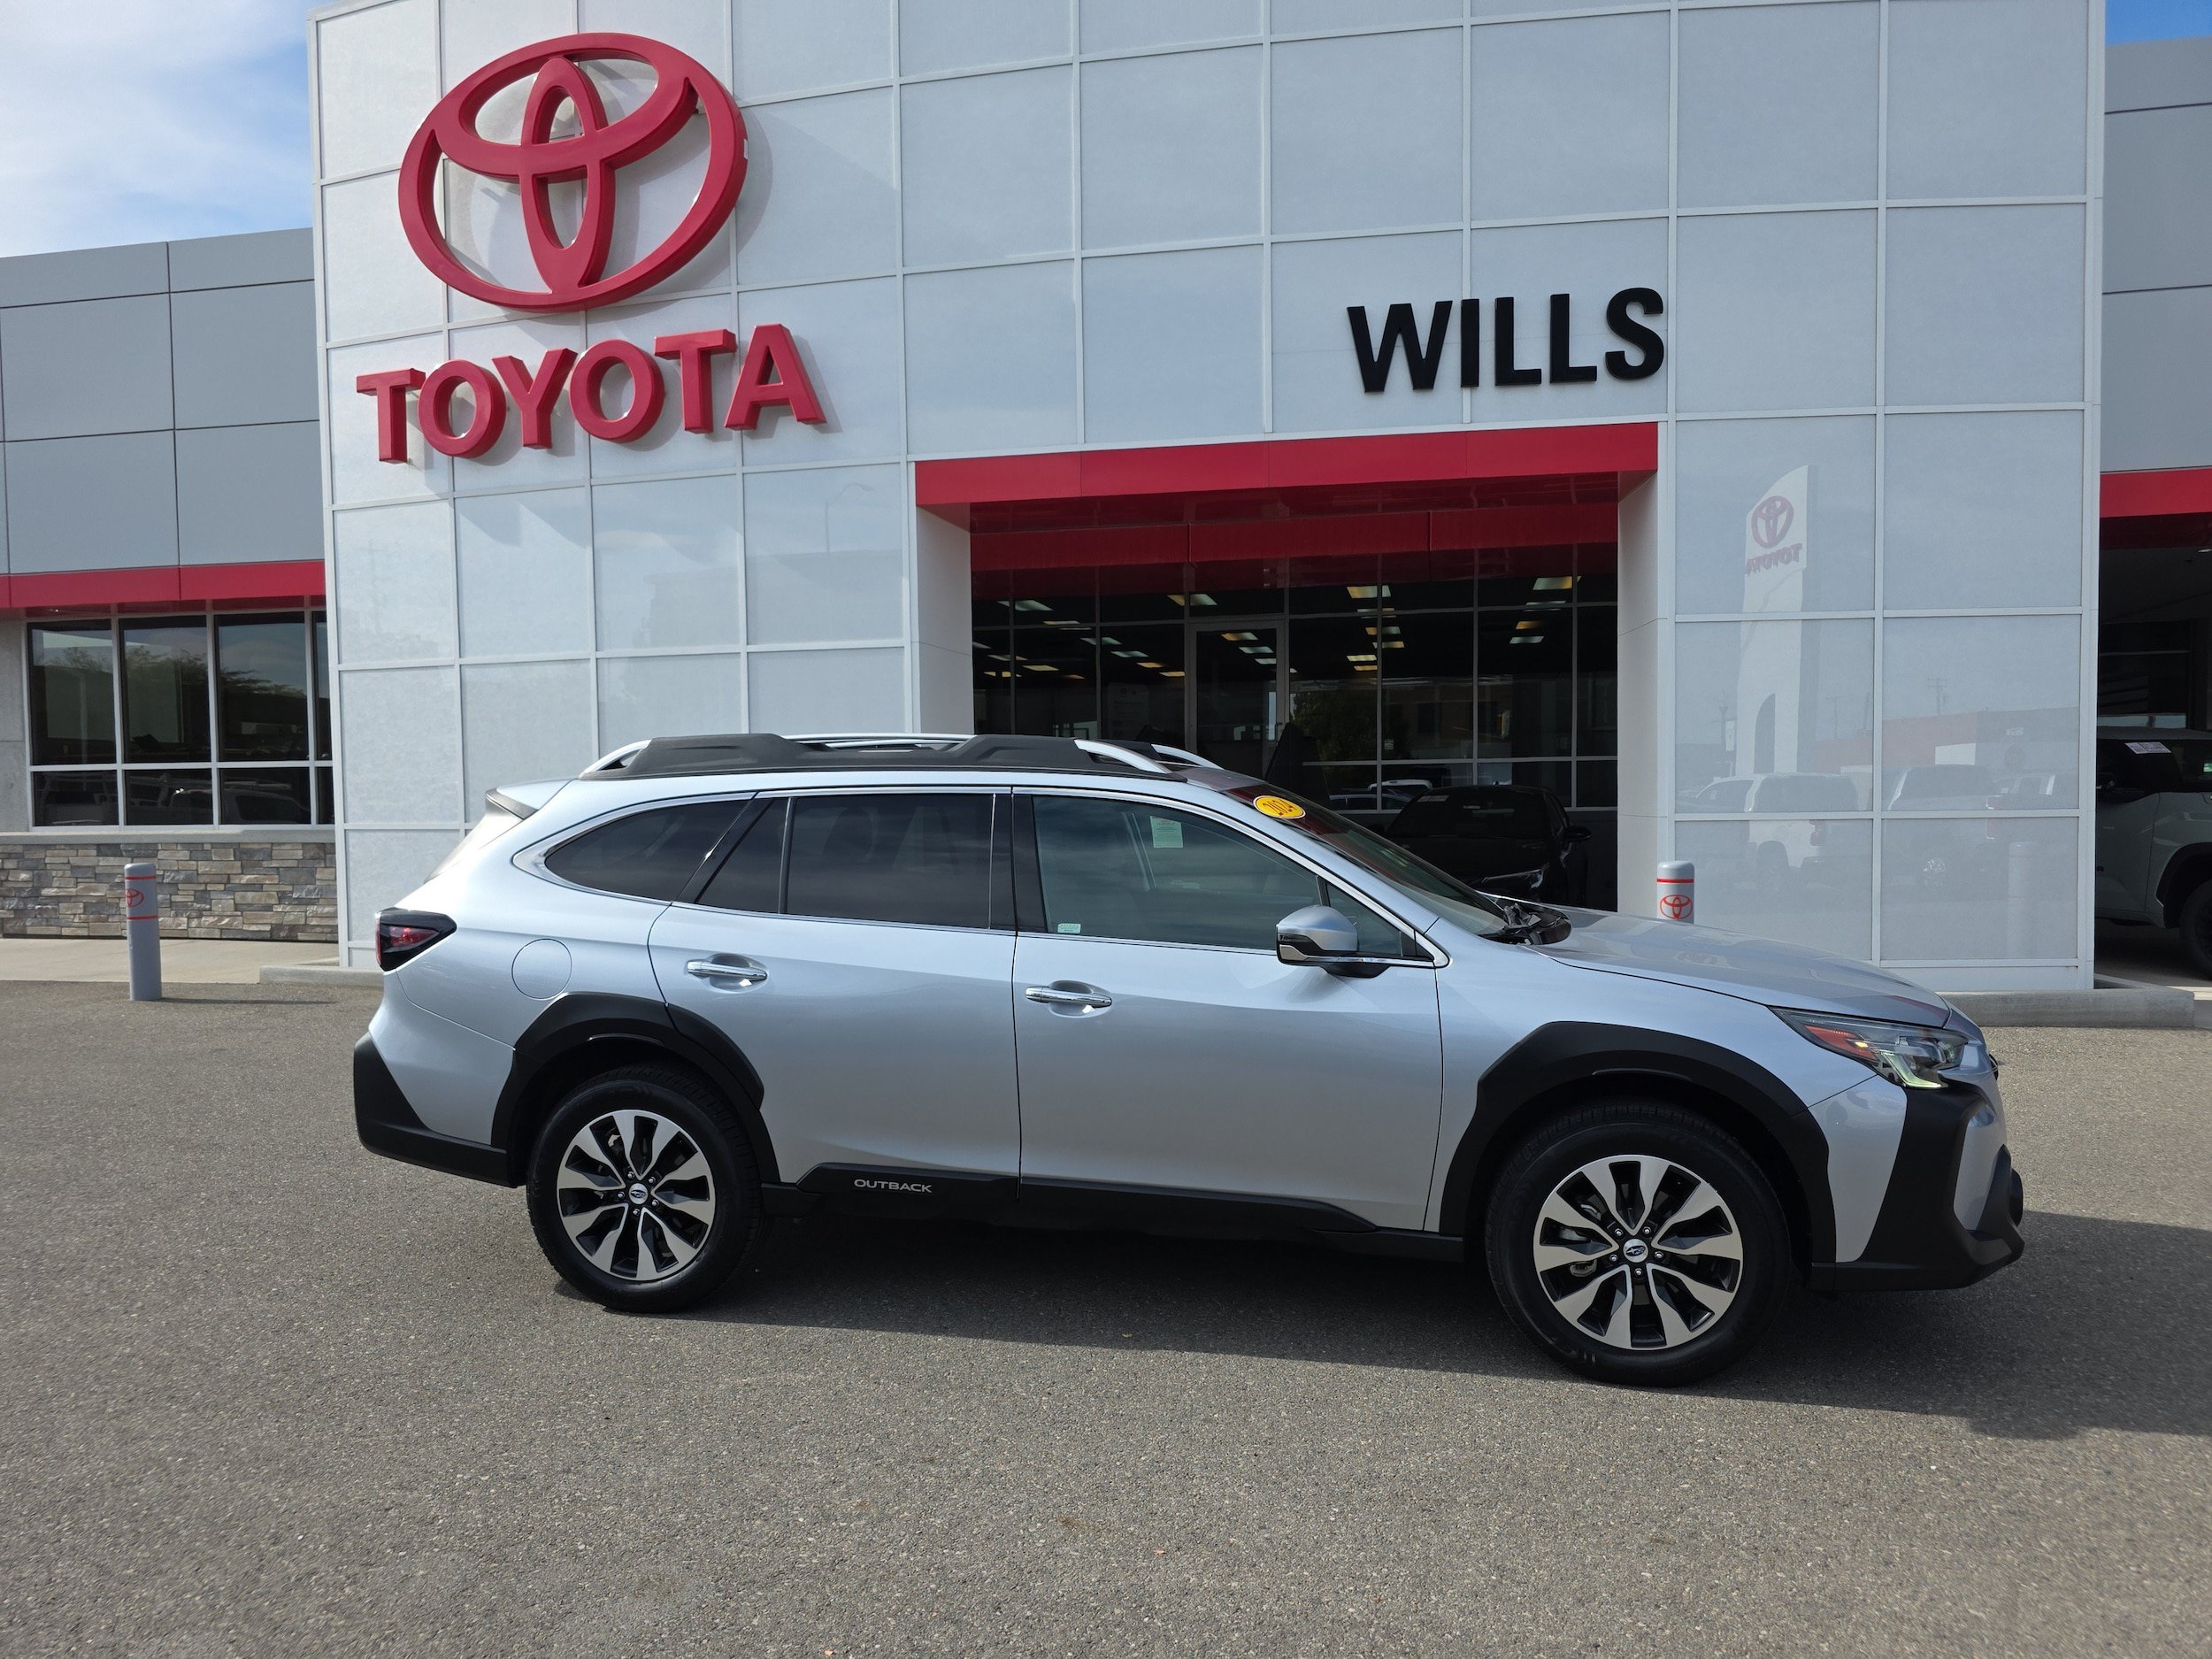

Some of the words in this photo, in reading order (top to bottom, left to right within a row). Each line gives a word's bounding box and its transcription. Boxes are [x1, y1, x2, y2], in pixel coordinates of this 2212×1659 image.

[1347, 287, 1664, 393] WILLS
[357, 323, 826, 464] TOYOTA
[854, 1179, 933, 1194] OUTBACK
